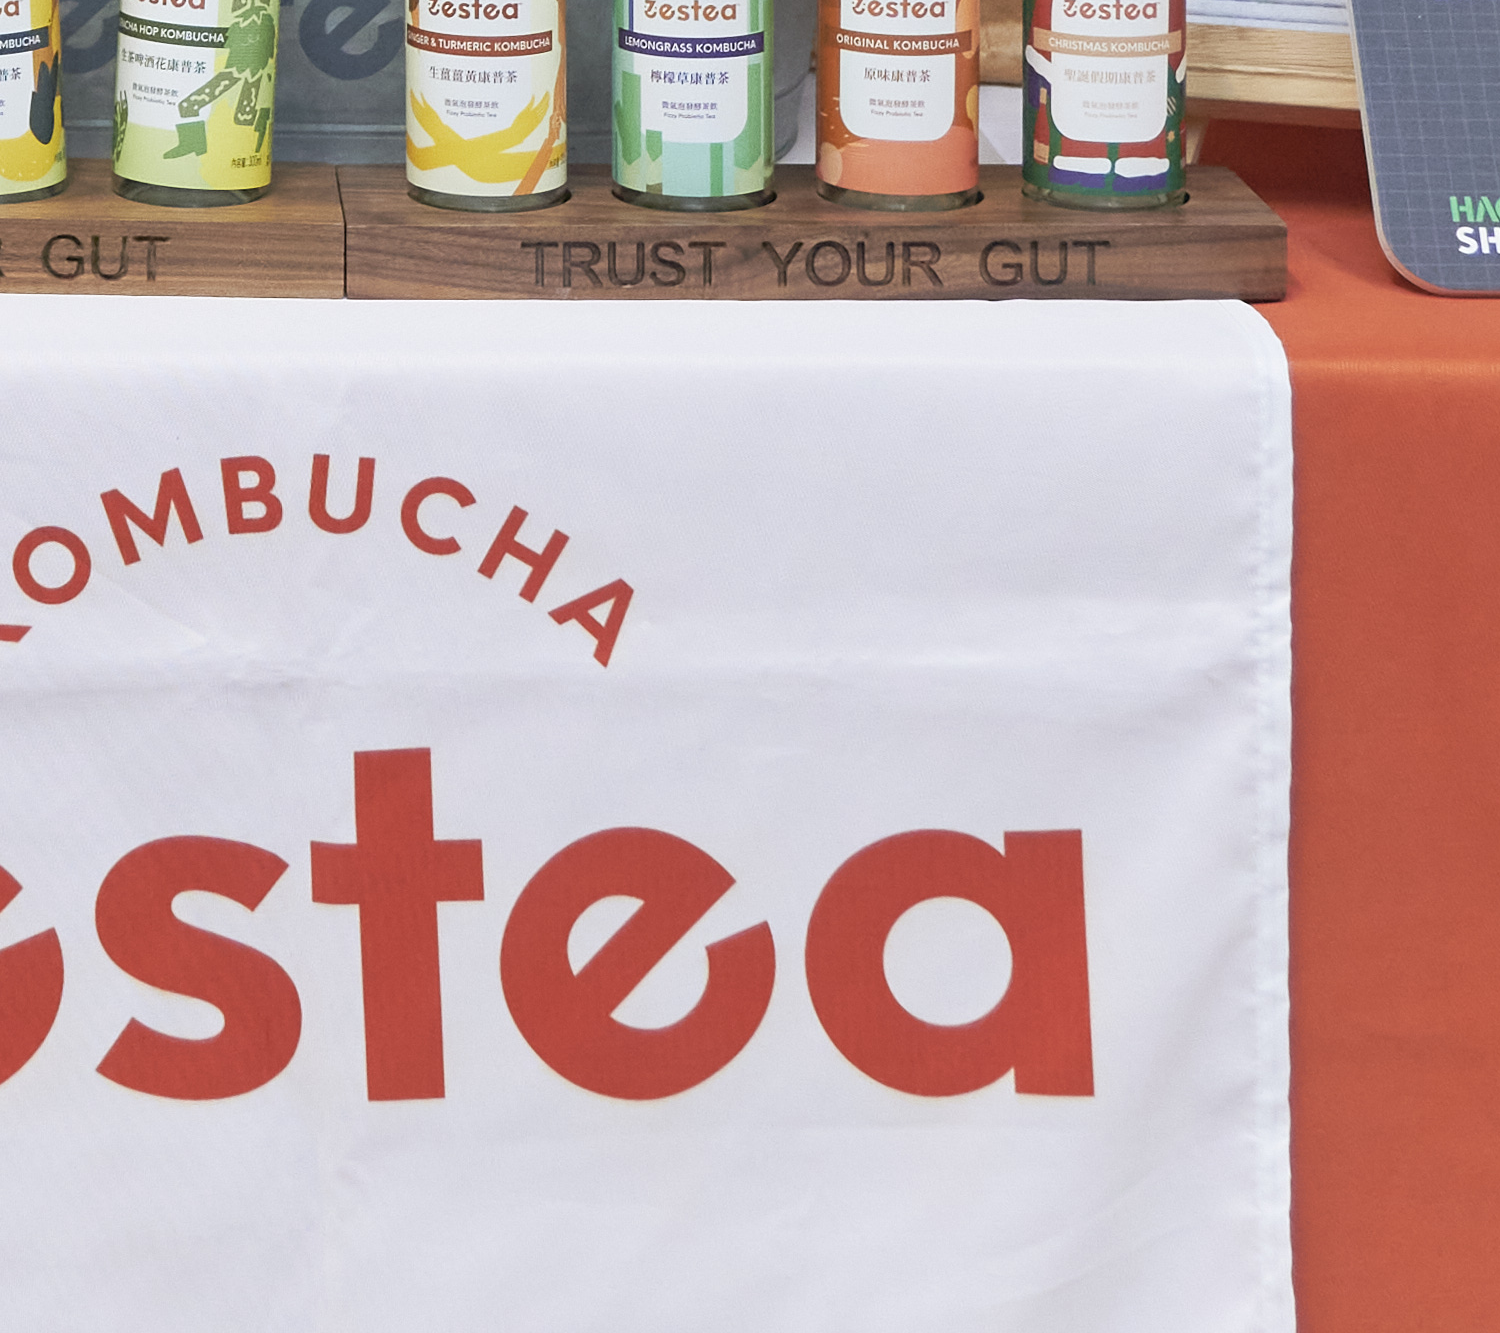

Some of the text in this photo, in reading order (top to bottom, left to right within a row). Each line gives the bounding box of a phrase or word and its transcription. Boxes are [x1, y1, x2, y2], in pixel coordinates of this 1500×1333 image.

[644, 0, 737, 21] zestea
[139, 24, 159, 36] HOP
[160, 28, 225, 43] KOMBUCHA
[836, 33, 960, 51] ORIGINAL KOMBUCHA
[431, 37, 550, 52] & TURMERIC KOMBUCHA
[625, 35, 756, 53] LEMONGRASS KOMBUCHA
[1048, 37, 1170, 53] CHRISTMAS KOMBUCHA
[864, 66, 931, 83] 原味康普茶
[42, 233, 170, 283] GUT
[520, 239, 1111, 288] TRUST YOUR GUT
